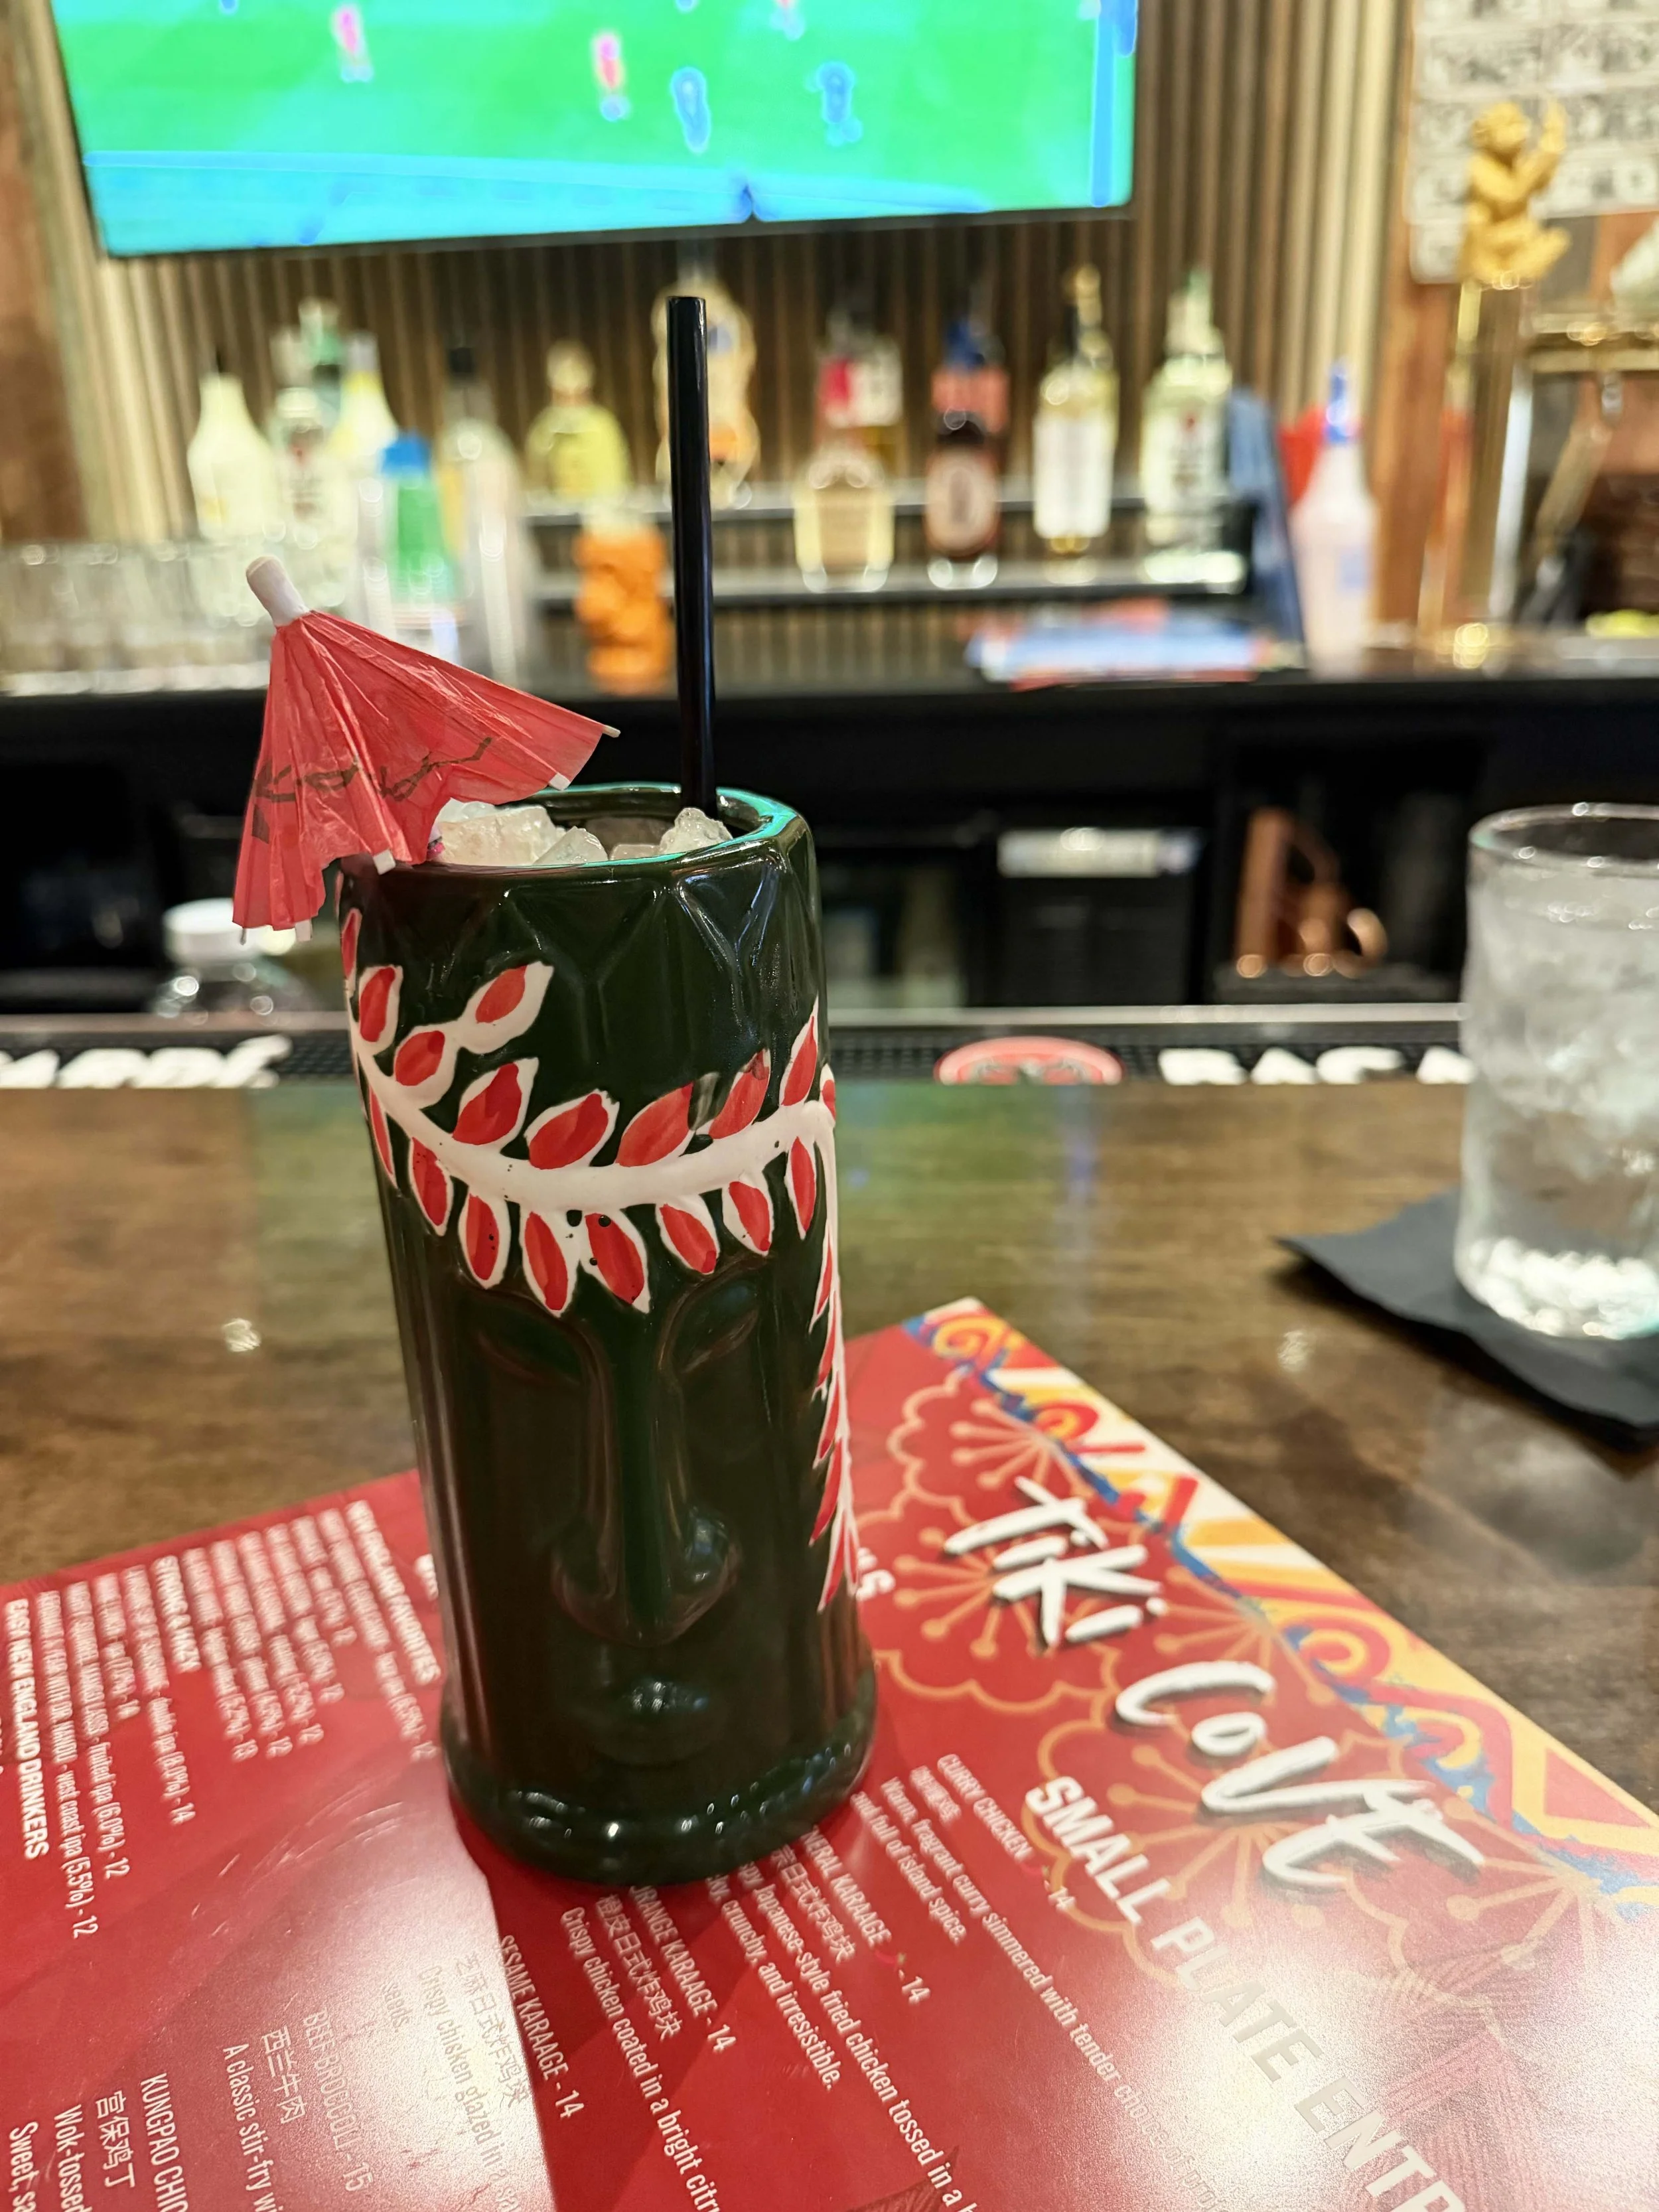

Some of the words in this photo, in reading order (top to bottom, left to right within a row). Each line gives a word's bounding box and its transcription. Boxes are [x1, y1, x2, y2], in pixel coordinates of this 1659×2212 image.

[156, 1556, 186, 1615] STRONG
[172, 1627, 199, 1670] HAZY
[389, 1595, 439, 1682] FAVORITES
[9, 1639, 33, 1677] NEW
[12, 1677, 39, 1758] ENGLAND
[267, 1735, 293, 1756] 12
[56, 1770, 80, 1800] west
[88, 1742, 115, 1783] fruited
[91, 1781, 115, 1804] ipa
[158, 1751, 188, 1798] (8.0%)
[19, 1759, 48, 1858] DRINKERS
[59, 1800, 84, 1836] coast
[94, 1802, 124, 1851] (6.0%)
[171, 1803, 195, 1824] 14
[938, 1754, 984, 1799] CURRY
[974, 1797, 1031, 1859] CHICKEN
[1048, 1885, 1076, 1911] 14
[60, 1834, 86, 1858] ipa
[104, 1857, 129, 1879] 12
[865, 1812, 899, 1842] full
[885, 1834, 910, 1858] of
[898, 1852, 941, 1900] island
[928, 1893, 966, 1943] spice.
[62, 1856, 94, 1907] (5.5%)
[770, 1844, 856, 1964] 宗日式炸鸡块
[72, 1915, 98, 1938] 12
[561, 1907, 595, 1958] Crispy
[800, 1830, 843, 1880] NERAL
[831, 1874, 890, 1945] KARAAGE
[902, 1976, 930, 2002] 14
[1025, 1775, 1170, 1925] SMALL
[1151, 1915, 1323, 2085] PLATE
[501, 1934, 537, 2000] SESAME
[912, 1819, 963, 1878] fragrant
[953, 1874, 990, 1915] curry
[983, 1913, 1052, 1990] simmered
[1041, 1987, 1078, 2027] with
[1070, 2024, 1126, 2087] tender
[583, 1956, 624, 2018] chicken
[662, 1940, 717, 2016] KARAAGE
[707, 2024, 735, 2051] 14
[722, 1901, 766, 1965] crunchy,
[758, 1962, 792, 1996] and
[777, 1992, 839, 2089] irresistible.
[222, 2043, 249, 2059] A
[303, 2006, 335, 2053] BEEF
[516, 1998, 567, 2079] KARAAGE
[613, 2018, 658, 2077] coated
[755, 1885, 830, 1993] Japanese-style
[820, 1990, 860, 2033] fried
[846, 2033, 897, 2101] chicken
[889, 2100, 943, 2165] tossed
[927, 2162, 952, 2188] in
[942, 2189, 962, 2207] a
[226, 2060, 259, 2120] classic
[261, 2025, 307, 2124] 西兰牛肉
[417, 1965, 449, 2017] Crispy
[455, 2086, 502, 2145] glazed
[480, 2142, 504, 2168] in
[640, 2074, 662, 2098] in
[141, 2073, 179, 2164] KUNGPAO
[315, 2054, 362, 2150] BROCCOLI
[555, 2090, 584, 2117] 14
[650, 2098, 669, 2114] a
[9, 2122, 38, 2191] Sweet,
[55, 2105, 91, 2212] Wok-tossed
[96, 2091, 134, 2187] 宫保鸡丁
[239, 2122, 273, 2195] stir-fry
[658, 2110, 701, 2174] bright
[343, 2162, 373, 2191] 15
